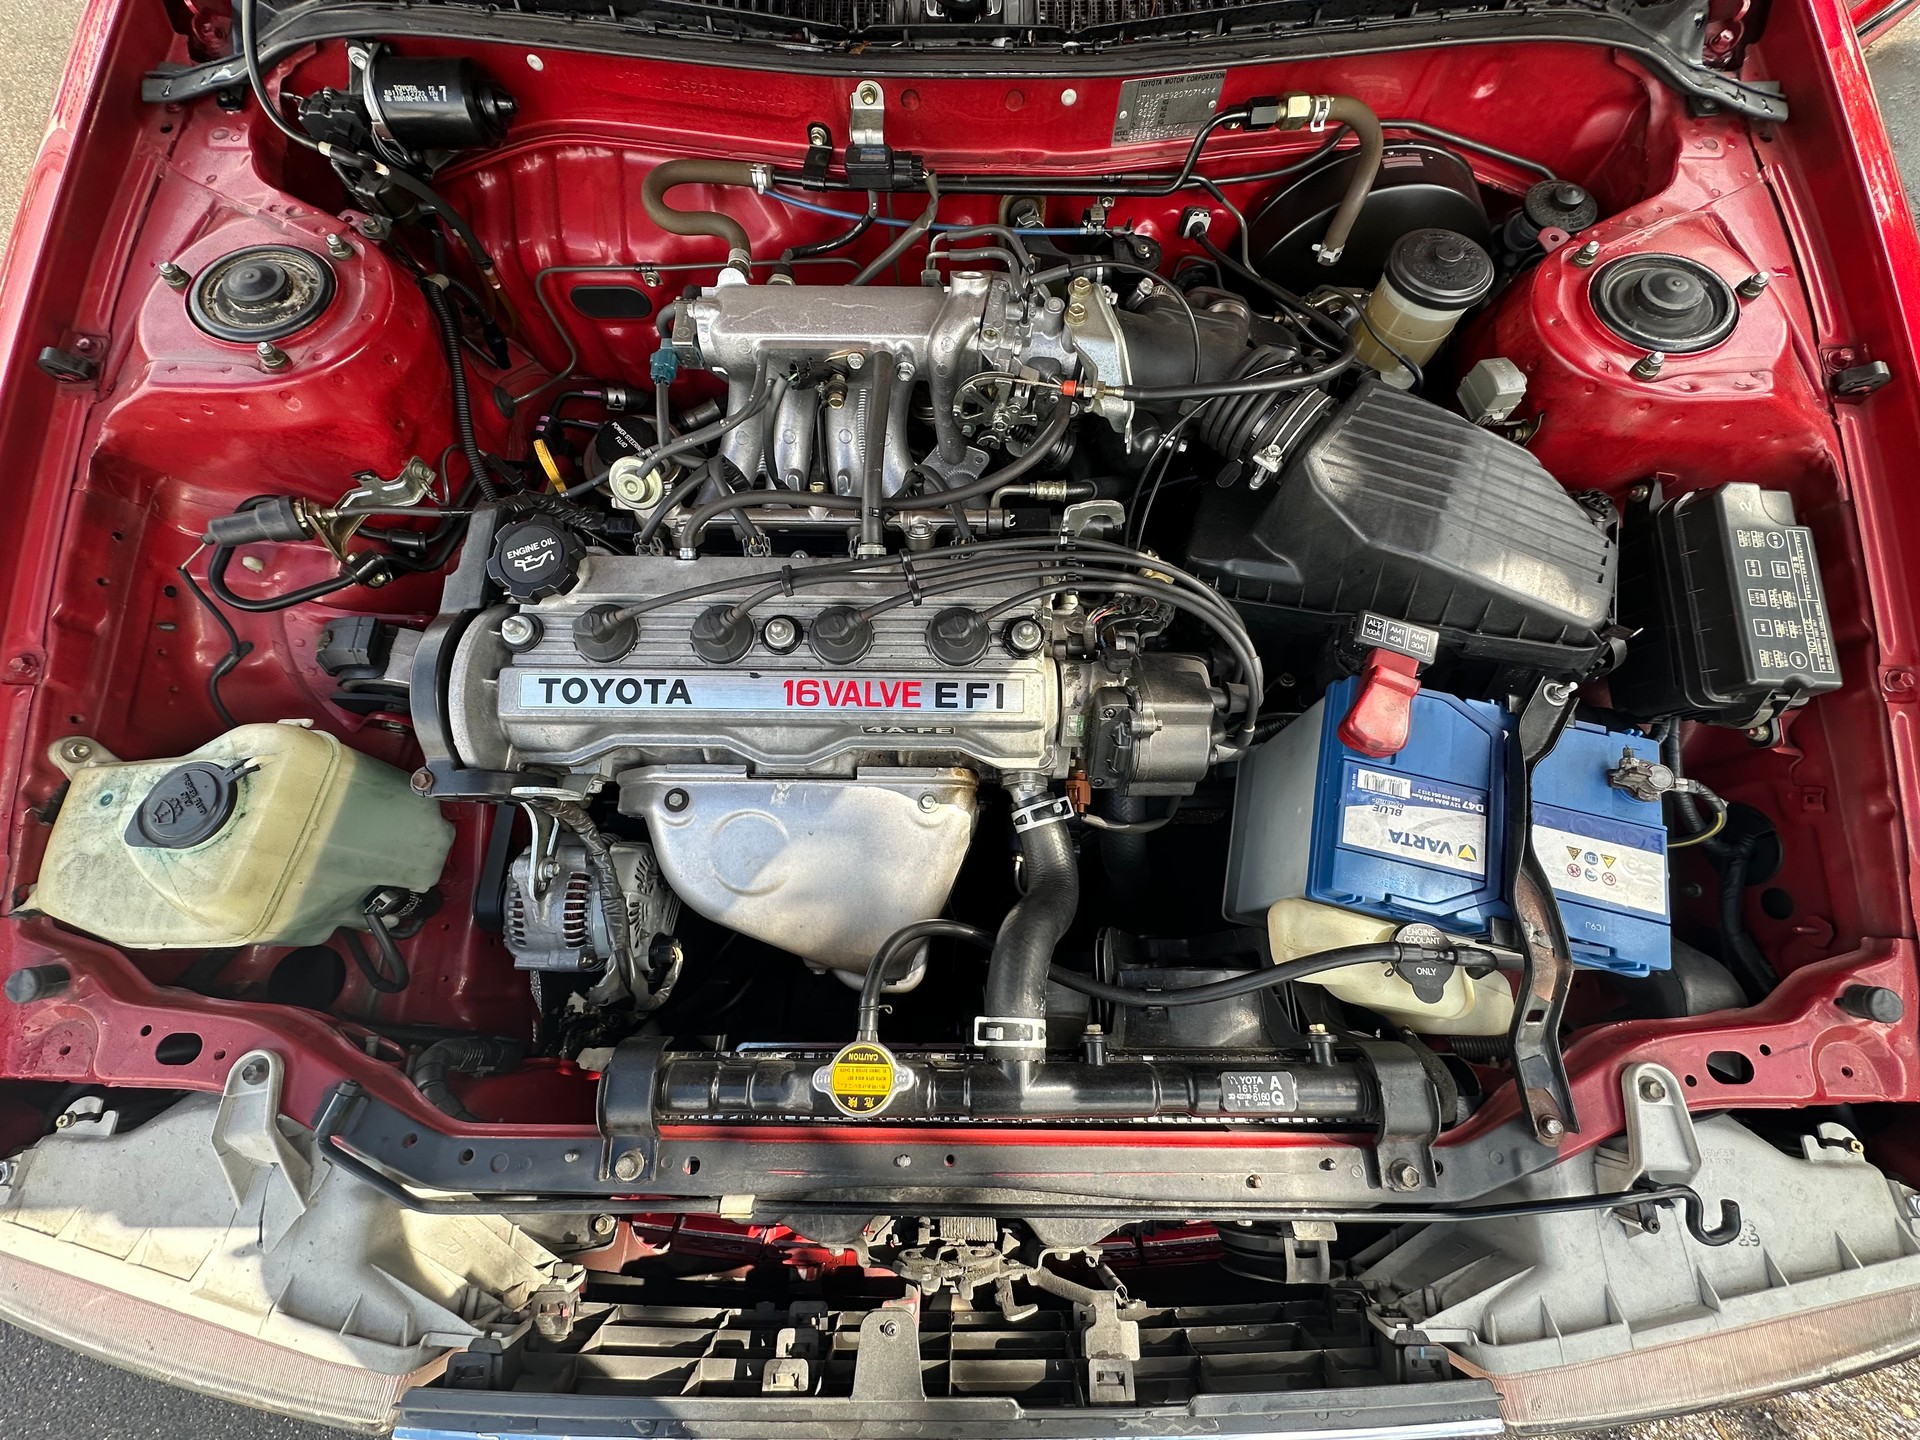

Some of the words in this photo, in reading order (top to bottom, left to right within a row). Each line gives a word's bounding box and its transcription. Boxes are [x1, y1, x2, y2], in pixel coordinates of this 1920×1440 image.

[1140, 80, 1162, 88] TOYOTA
[1164, 77, 1184, 85] MOTOR
[1186, 72, 1225, 83] CORPORATION
[438, 85, 447, 102] 7
[611, 421, 627, 437] POWER
[614, 436, 628, 449] FLUID
[506, 541, 540, 560] ENGINE
[540, 537, 556, 548] OIL
[1389, 626, 1405, 635] AM1
[1803, 617, 1817, 653] NOTICE
[1389, 635, 1402, 644] 40A
[1411, 633, 1427, 643] AM2
[1410, 641, 1425, 651] 30A
[538, 678, 692, 705] TOYOTA
[934, 682, 1006, 709] EFI
[866, 726, 952, 734] 4A-FE
[1372, 803, 1402, 817] BLUE
[1462, 800, 1484, 813] D47
[1388, 829, 1453, 857] VARTA
[1406, 928, 1437, 937] ENGINE
[1403, 936, 1440, 945] COOLANT
[1416, 967, 1437, 976] ONLY
[848, 1052, 879, 1061] CAUTION
[1237, 1084, 1259, 1093] 1615
[1269, 1075, 1283, 1091] A
[1271, 1090, 1285, 1106] Q
